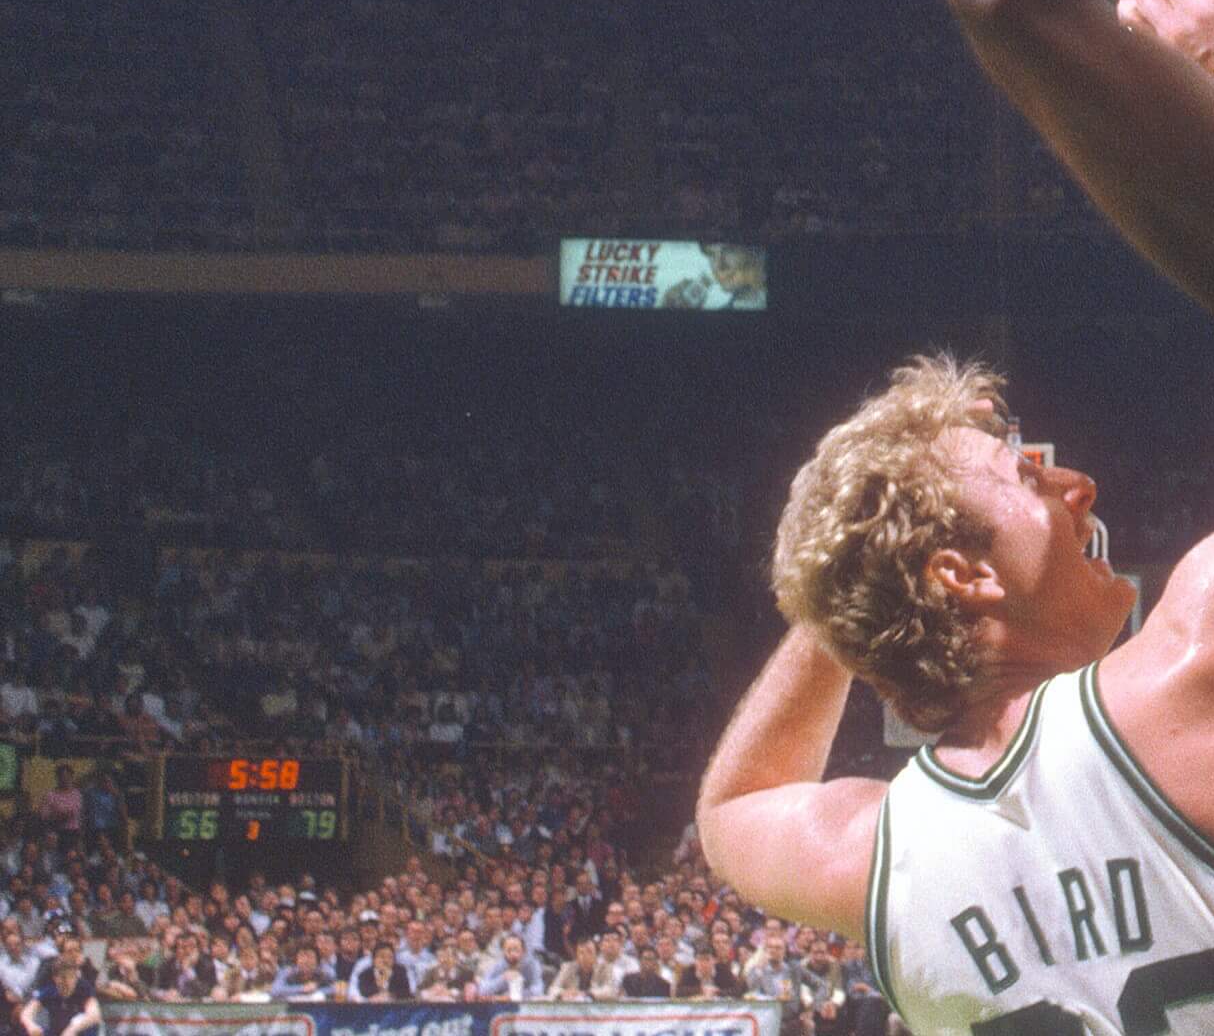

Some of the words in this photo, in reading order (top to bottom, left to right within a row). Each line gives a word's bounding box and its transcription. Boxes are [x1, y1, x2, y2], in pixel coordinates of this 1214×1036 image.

[585, 242, 661, 263] LUCKY
[576, 264, 659, 285] STRIKE
[569, 286, 659, 307] FILTERS
[228, 758, 300, 790] 5:58
[302, 810, 337, 840] 79
[950, 857, 1154, 996] BIRD
